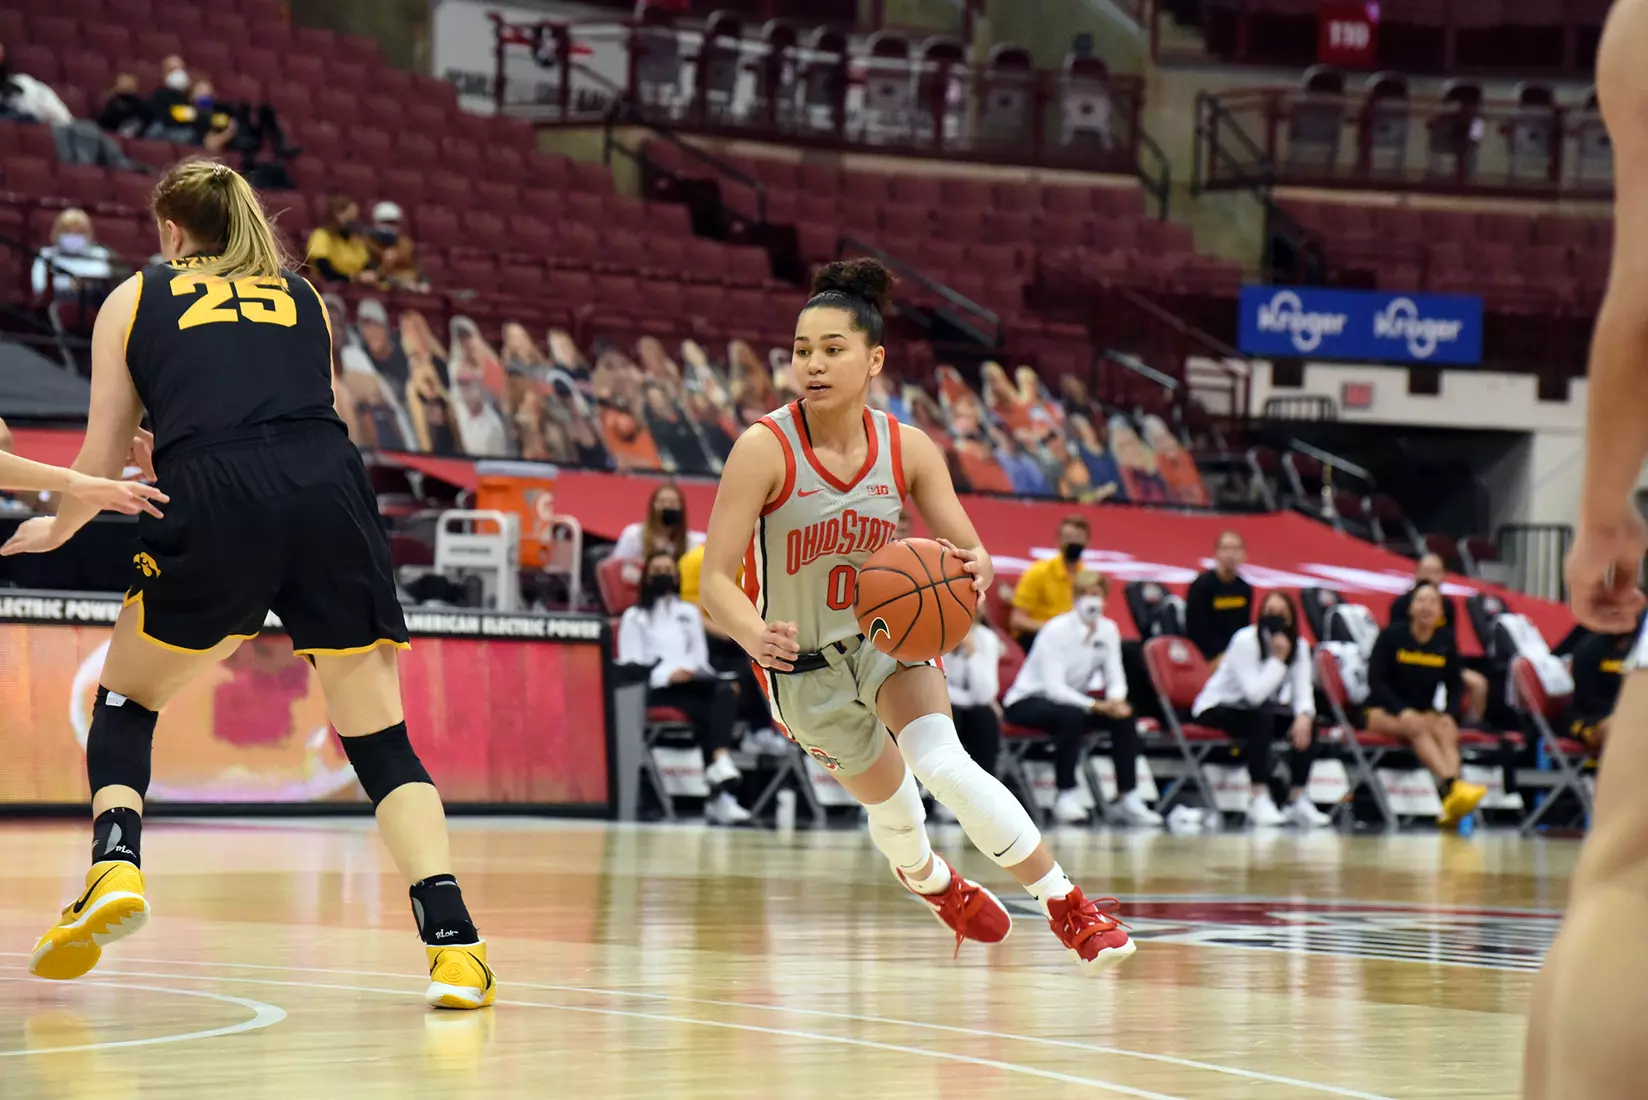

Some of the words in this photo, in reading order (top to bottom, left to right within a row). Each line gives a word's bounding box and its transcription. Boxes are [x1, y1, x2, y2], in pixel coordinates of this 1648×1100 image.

[169, 274, 298, 330] 25
[1256, 290, 1348, 353] Kroger
[1373, 297, 1462, 360] Kroger
[786, 517, 840, 576] OHIO
[826, 564, 857, 611] 0
[481, 616, 546, 635] ELECTRIC
[547, 619, 601, 639] POWER
